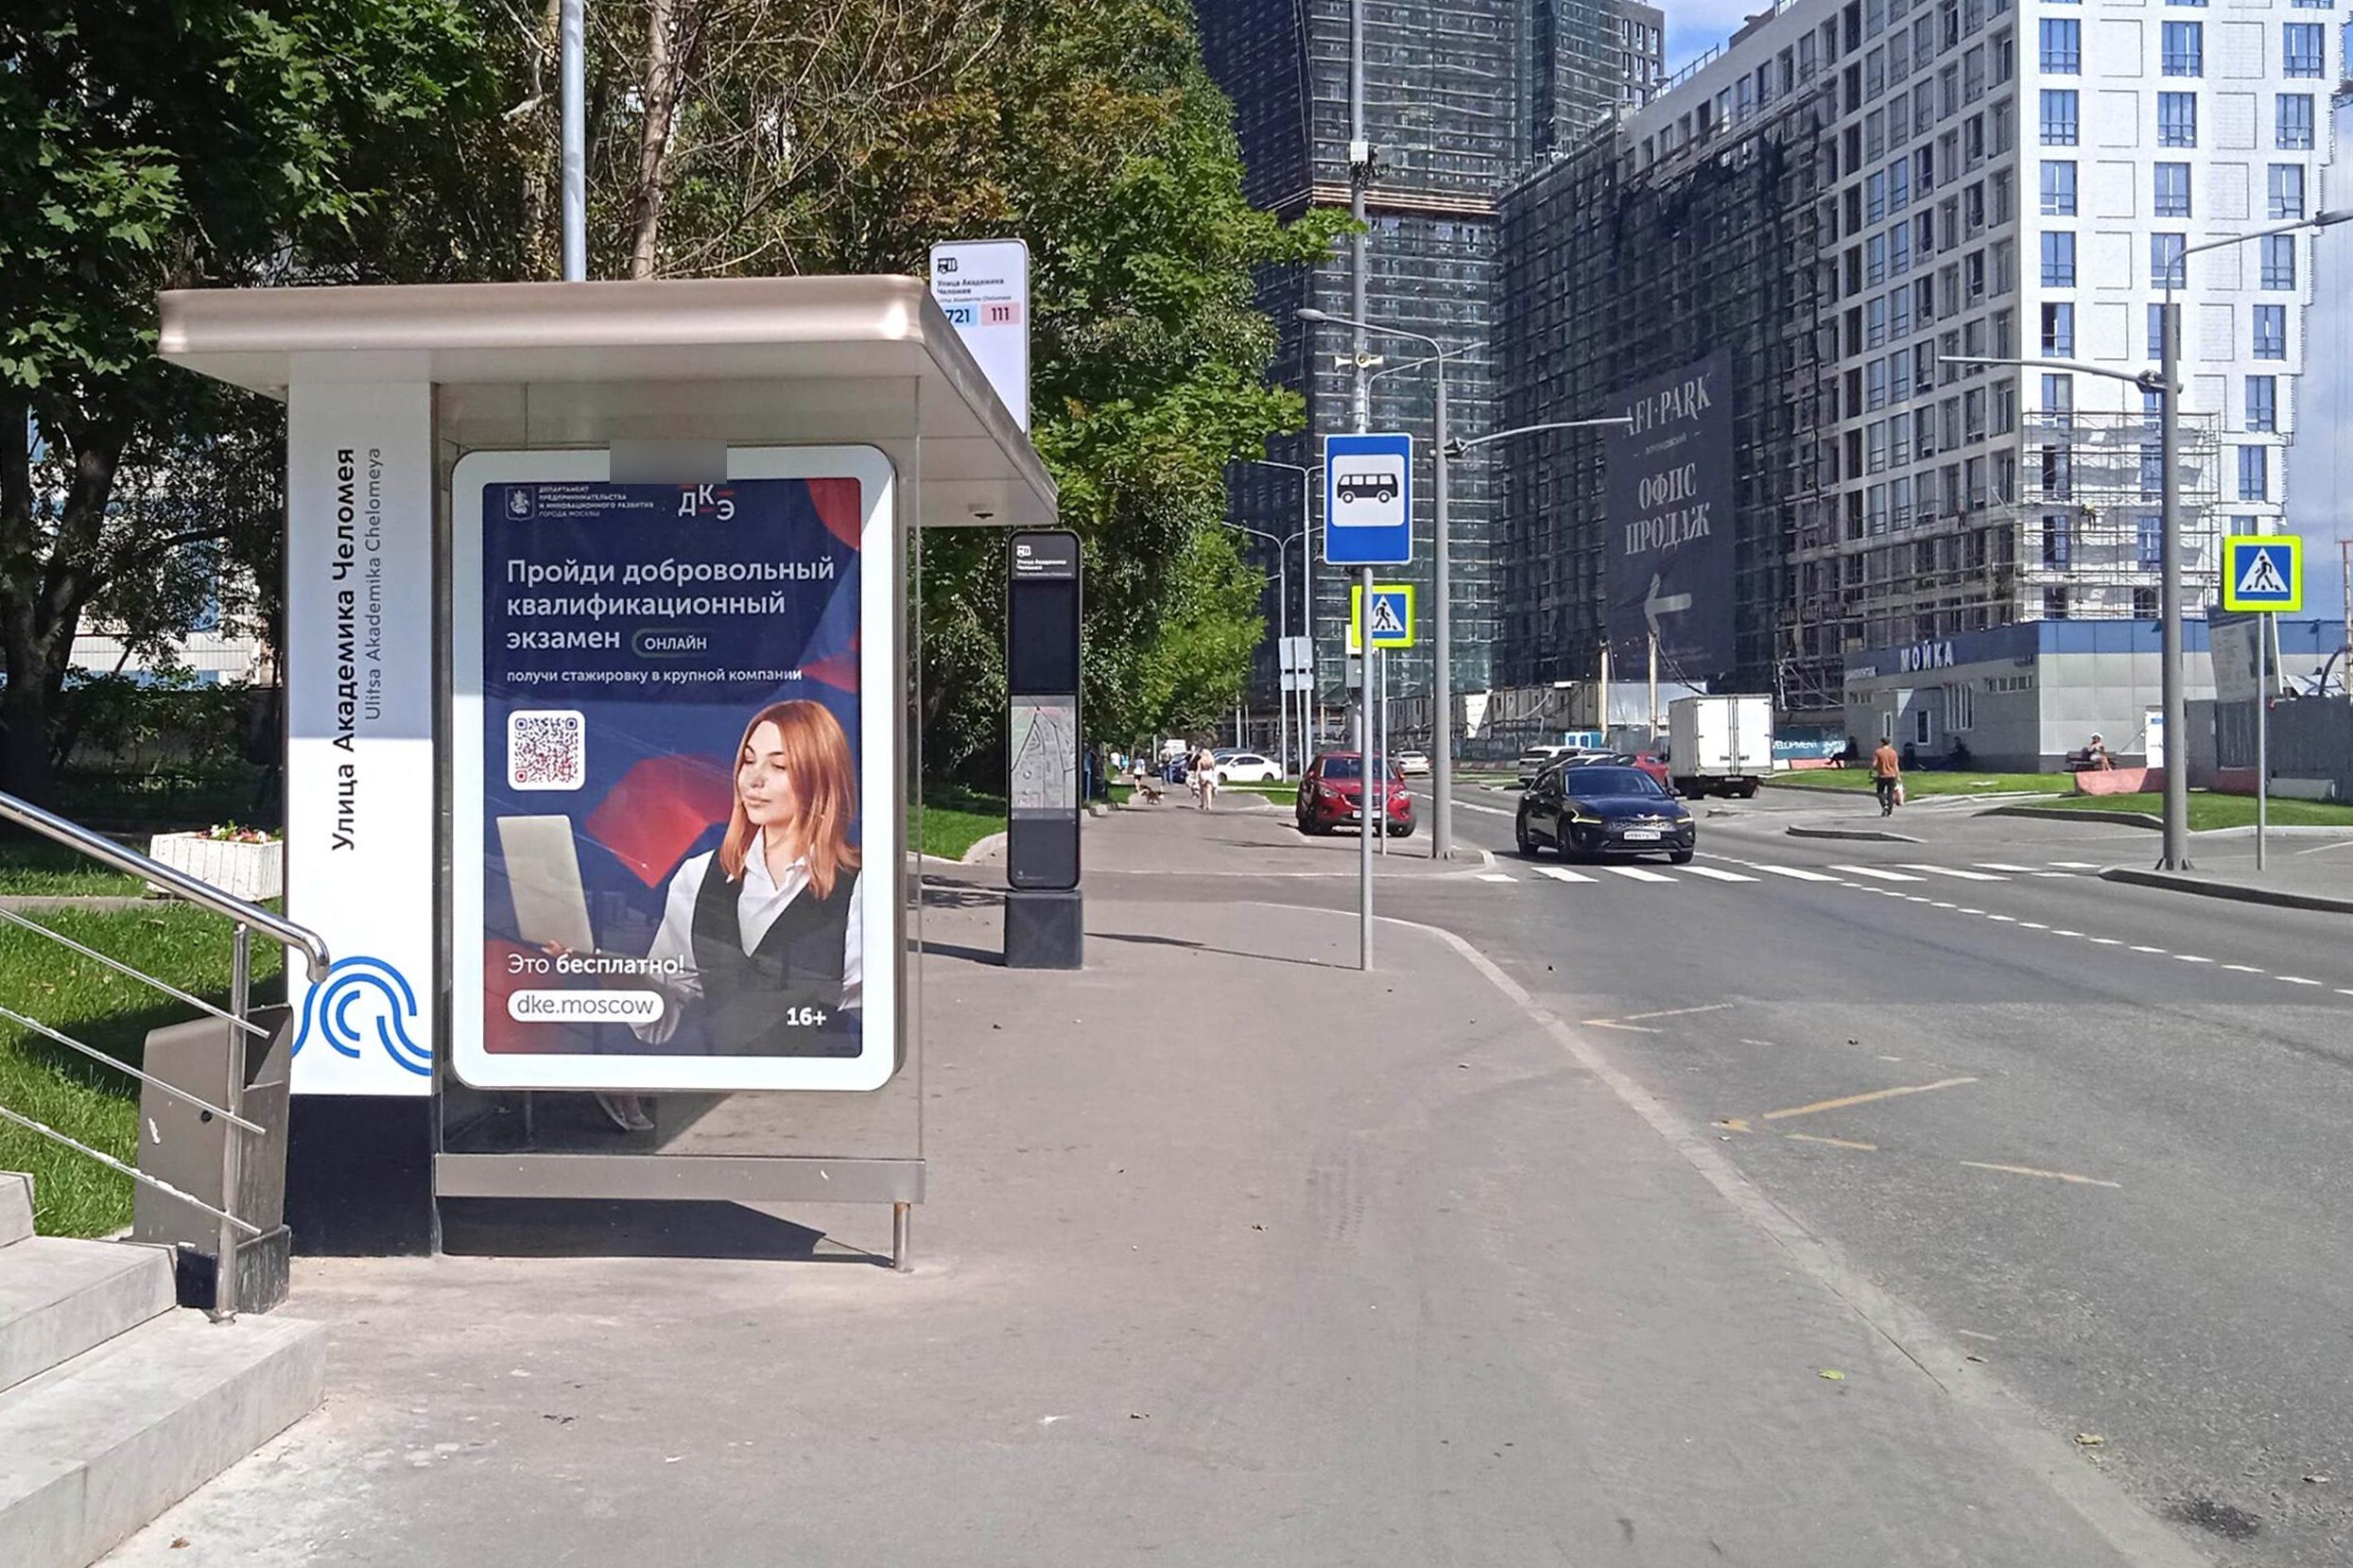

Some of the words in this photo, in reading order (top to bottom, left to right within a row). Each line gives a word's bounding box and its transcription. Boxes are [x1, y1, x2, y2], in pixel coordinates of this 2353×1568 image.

[945, 308, 970, 323] 721
[992, 307, 1009, 321] 111
[332, 448, 355, 581] Челомея
[364, 447, 385, 552] Chelomeya
[1625, 502, 1711, 556] ПРОДАЖ
[507, 559, 614, 587] Пройди
[622, 556, 835, 587] добровольный
[364, 558, 381, 662] Akademika
[507, 591, 786, 620] квалификационный
[507, 630, 620, 650] экзамен
[644, 634, 707, 650] ОНЛАЙН
[332, 588, 358, 753] Академика
[1901, 640, 1953, 672] МОЙКА
[507, 671, 558, 685] получи
[561, 670, 649, 685] стажировку
[652, 672, 660, 681] в
[664, 668, 725, 684] крупной
[729, 670, 803, 681] компании
[364, 668, 381, 720] Ulitsa
[332, 764, 358, 852] Улица
[508, 954, 549, 974] Это
[556, 954, 685, 975] бесплатно!
[516, 994, 654, 1015] dke.moscow
[786, 1007, 827, 1026] 16+
